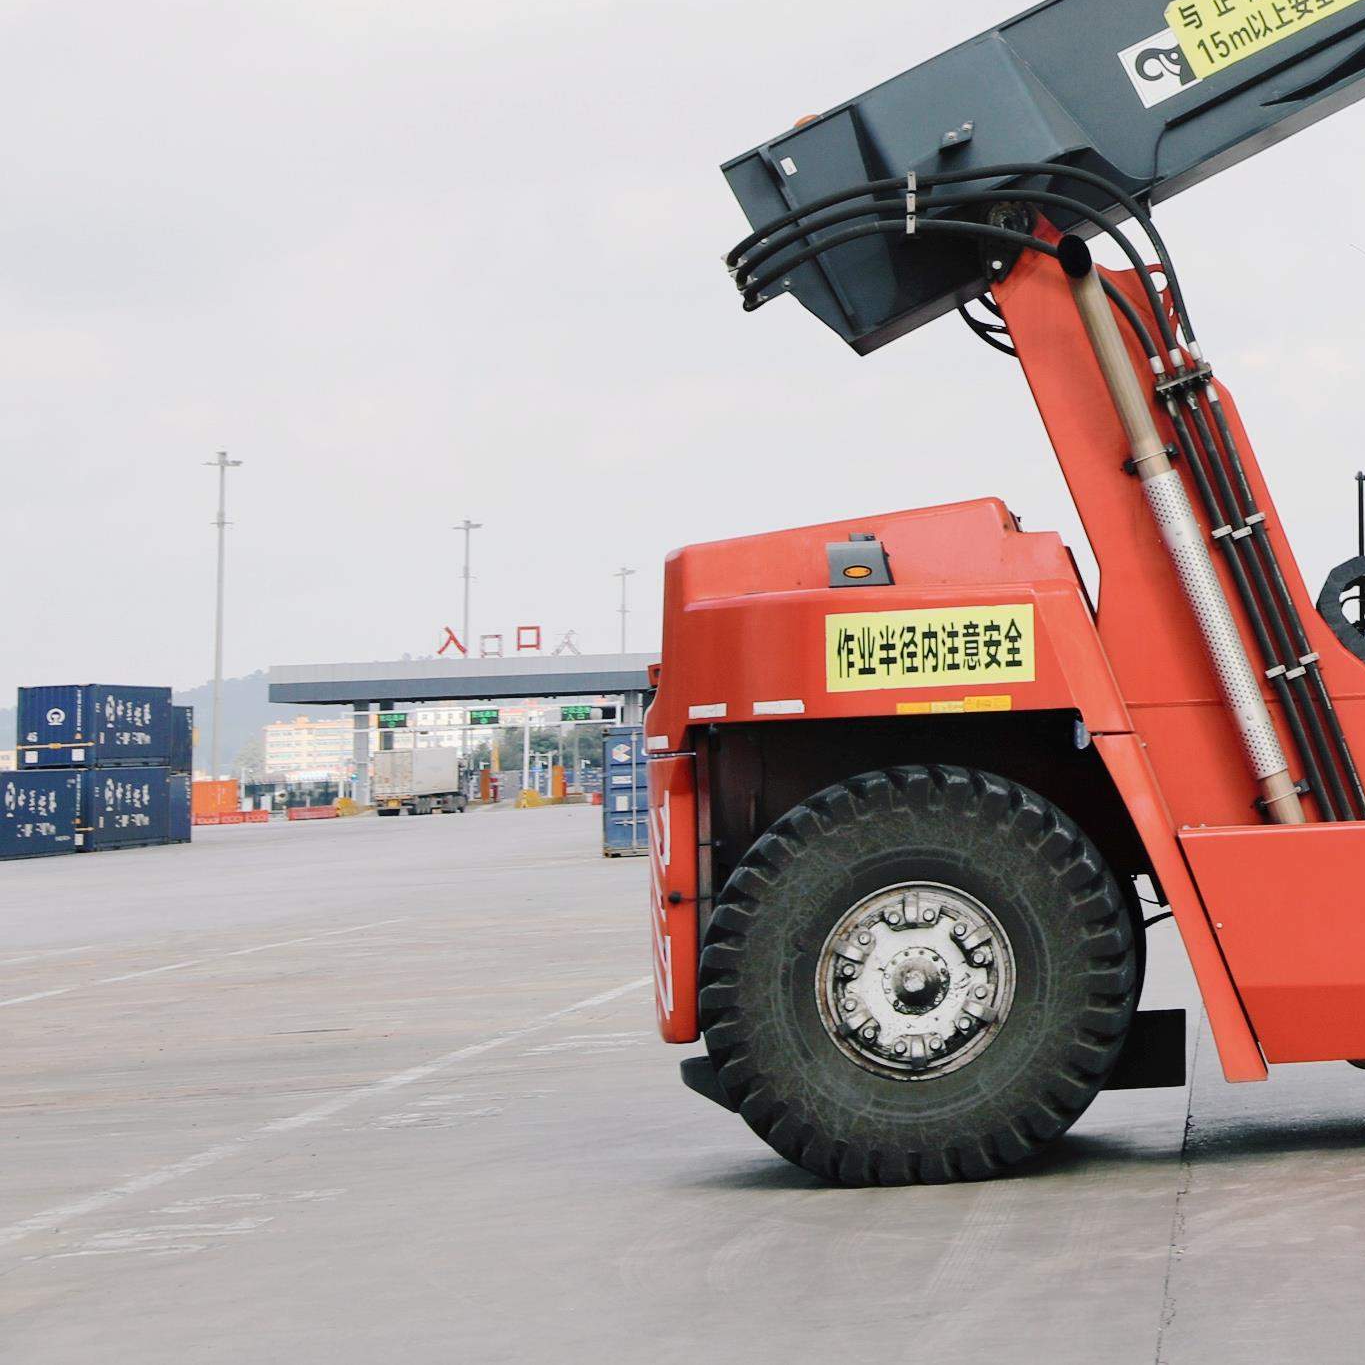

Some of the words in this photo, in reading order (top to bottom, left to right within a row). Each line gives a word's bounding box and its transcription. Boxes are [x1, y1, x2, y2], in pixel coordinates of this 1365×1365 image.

[836, 618, 1023, 679] 作业半径内注意安全
